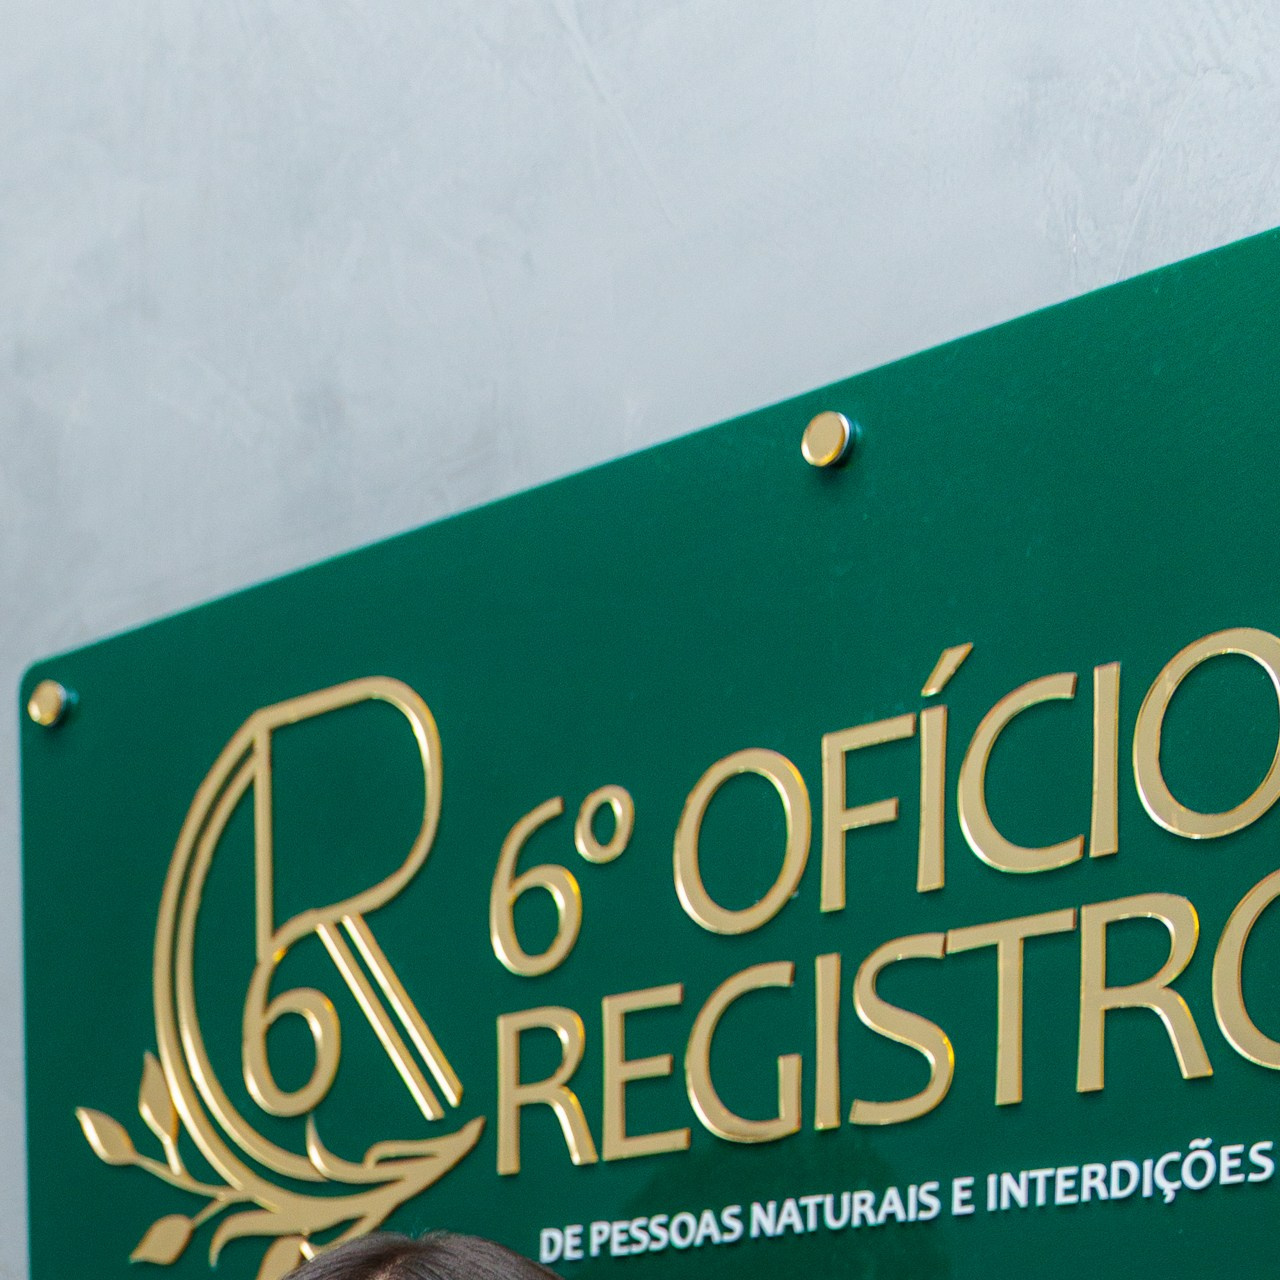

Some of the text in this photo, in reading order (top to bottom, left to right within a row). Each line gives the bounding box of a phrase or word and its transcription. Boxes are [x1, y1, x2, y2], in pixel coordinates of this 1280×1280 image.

[672, 628, 1280, 935] OFÍCIO
[539, 1137, 1276, 1264] DE PESSOAS NATURAIS E INTERDIÇÕES
